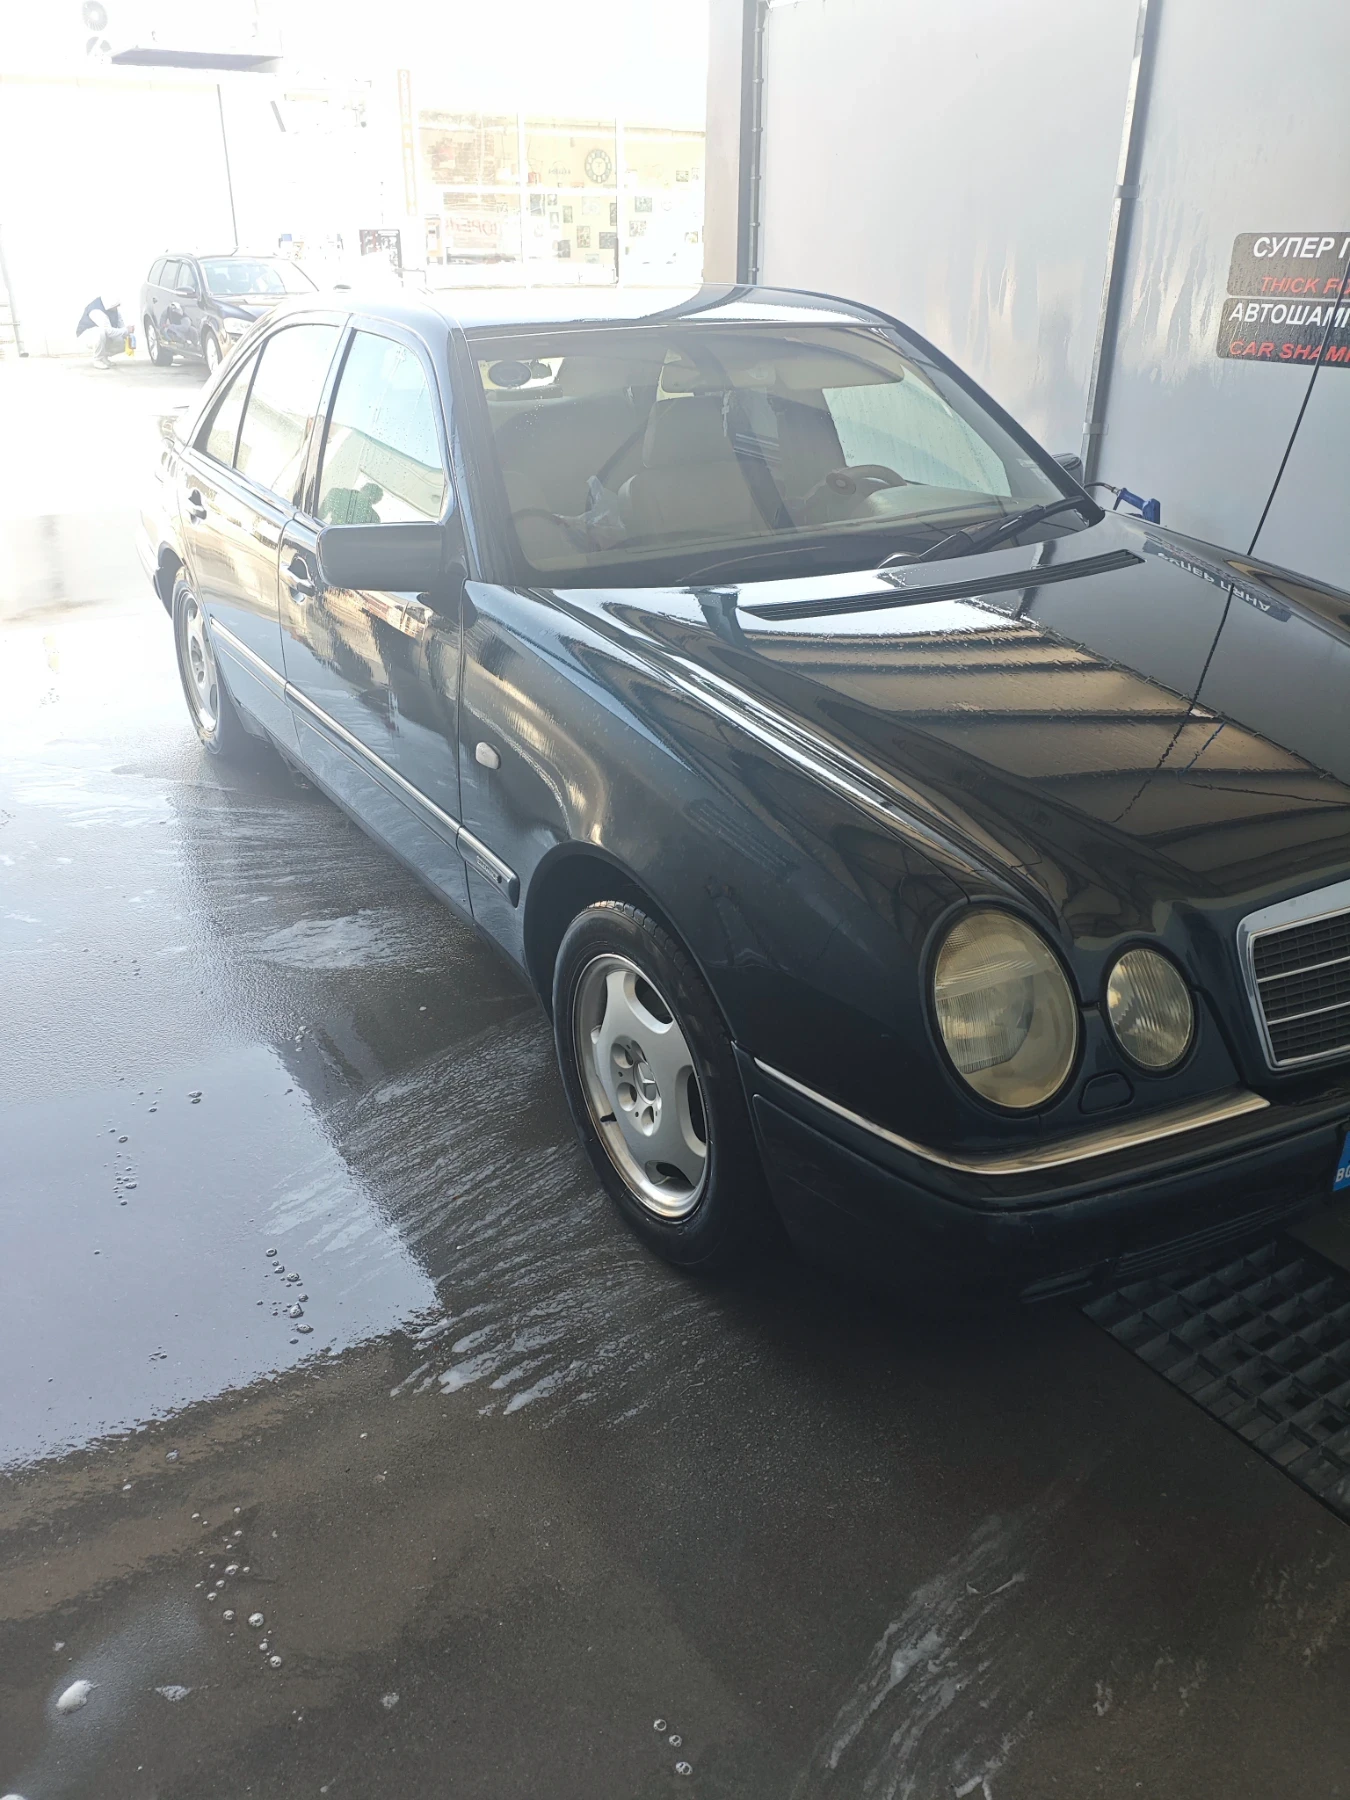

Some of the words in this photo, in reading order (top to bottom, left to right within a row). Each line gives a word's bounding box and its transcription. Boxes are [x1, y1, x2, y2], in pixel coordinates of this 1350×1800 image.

[1253, 236, 1336, 258] СУПЕР
[1261, 276, 1320, 293] THICK
[1229, 341, 1275, 357] CAR
